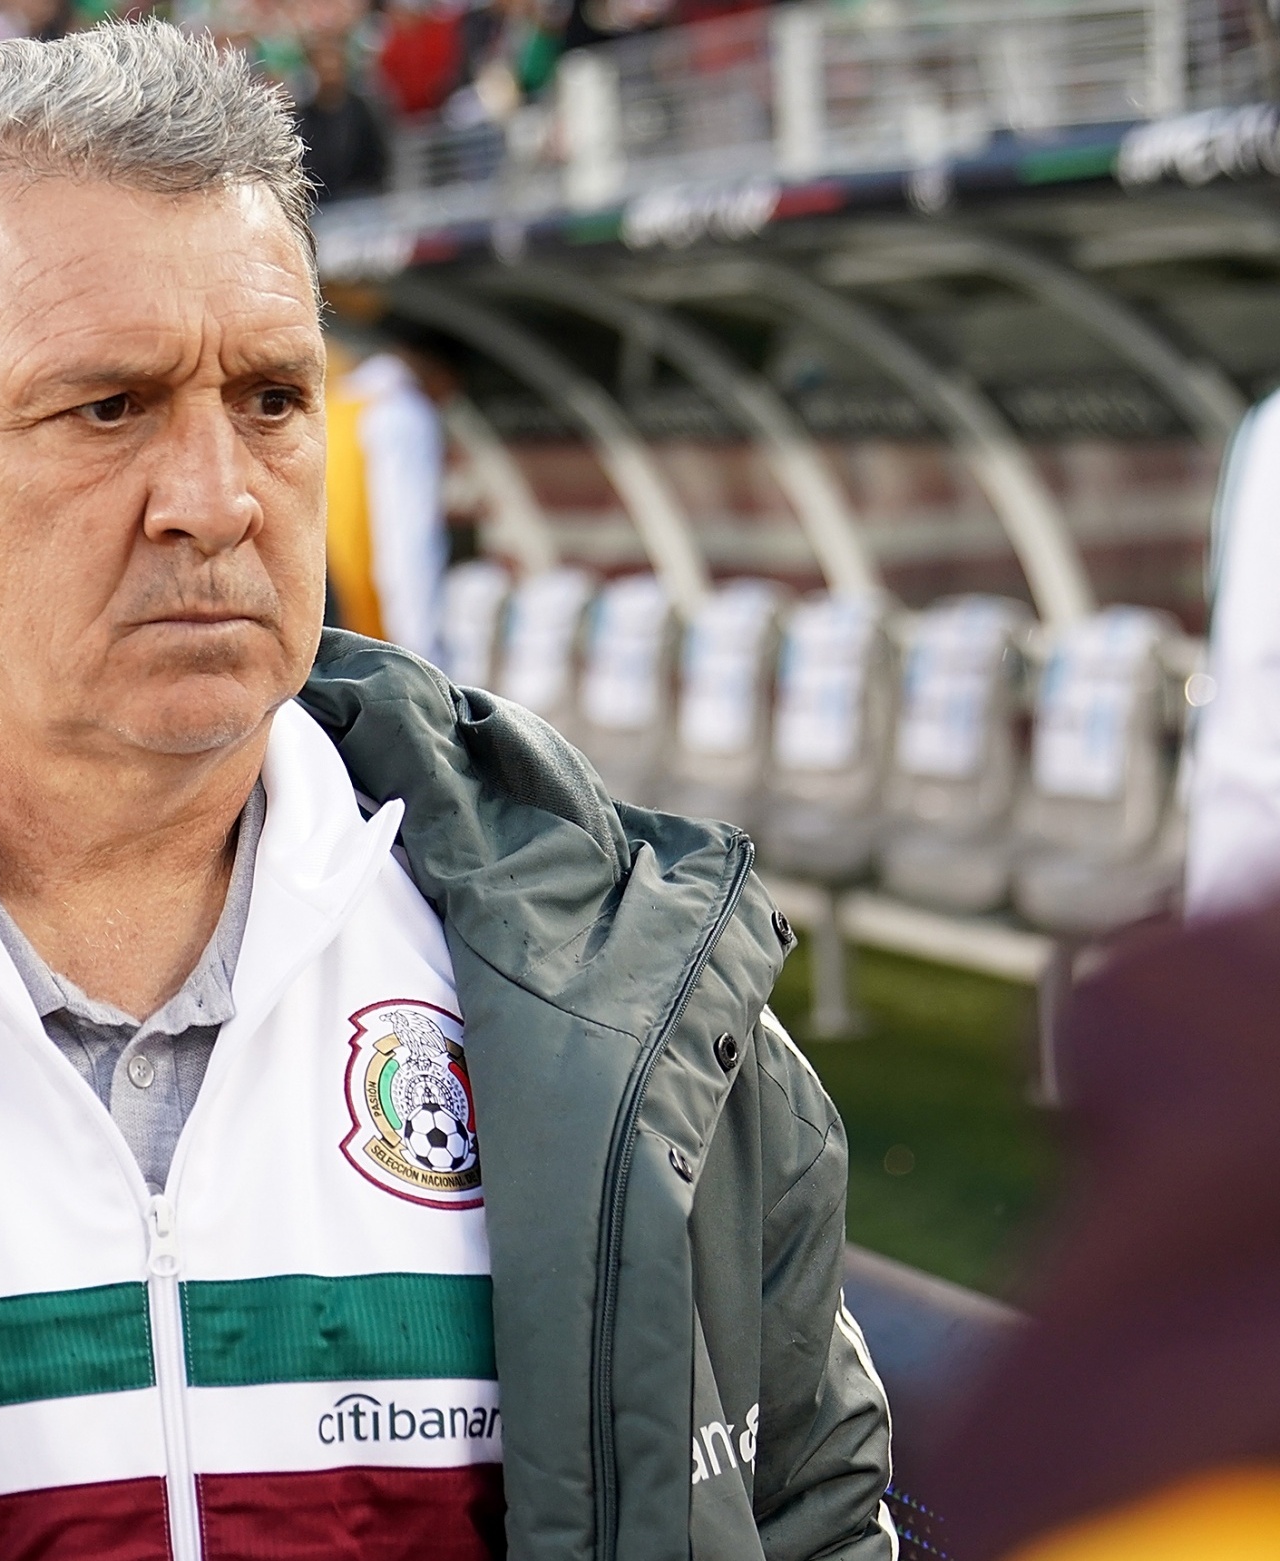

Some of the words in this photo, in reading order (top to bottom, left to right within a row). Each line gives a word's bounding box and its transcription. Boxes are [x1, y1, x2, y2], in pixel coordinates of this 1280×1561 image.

[367, 1080, 382, 1117] PASIÓN
[371, 1145, 419, 1181] SELECCIÓN
[421, 1174, 466, 1188] NACIONAL
